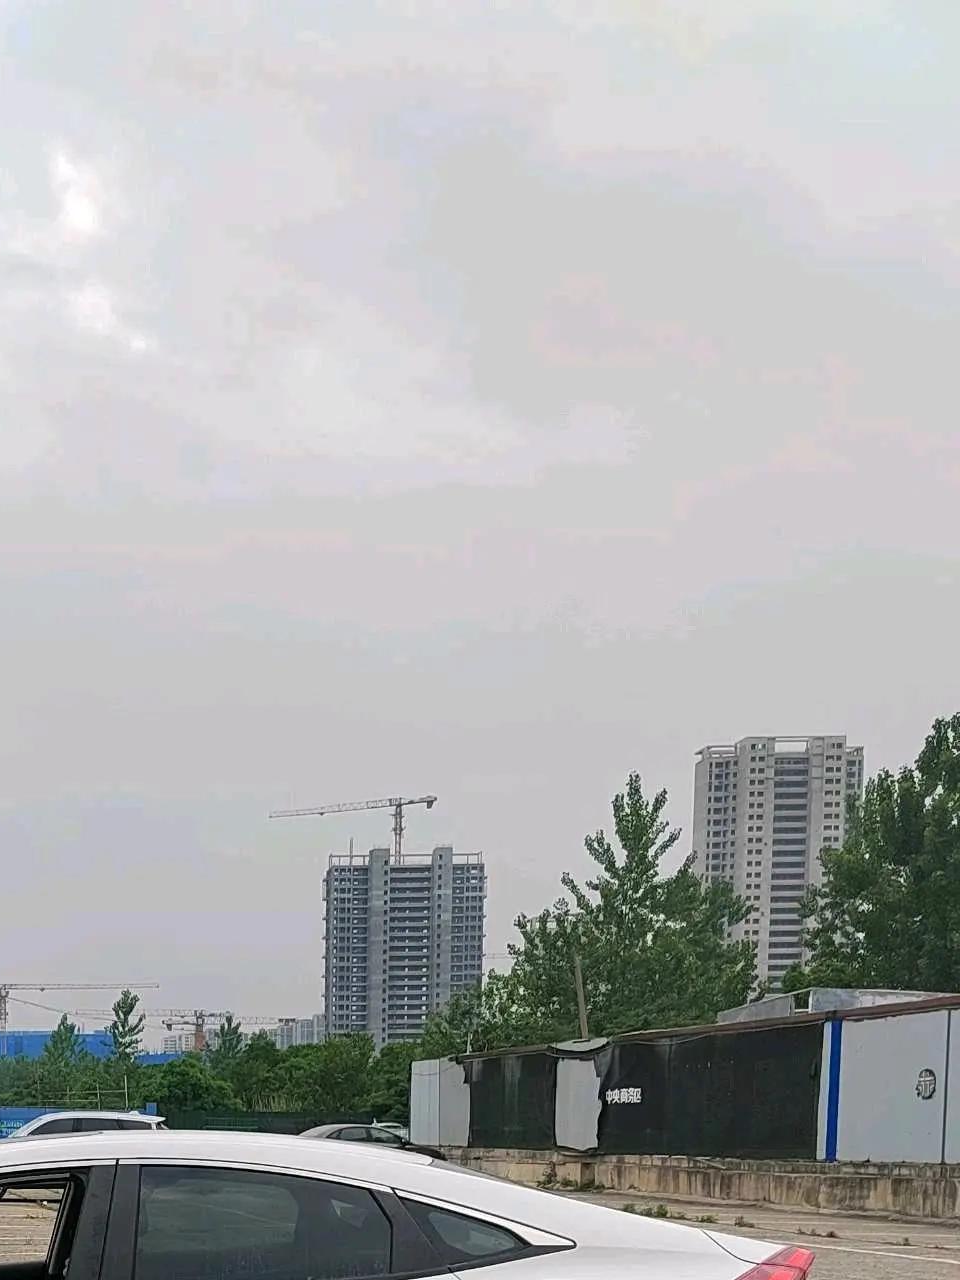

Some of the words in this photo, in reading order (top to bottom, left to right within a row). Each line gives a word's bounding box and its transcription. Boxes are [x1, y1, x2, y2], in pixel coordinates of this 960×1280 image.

[605, 1087, 642, 1105] 中央商务区
